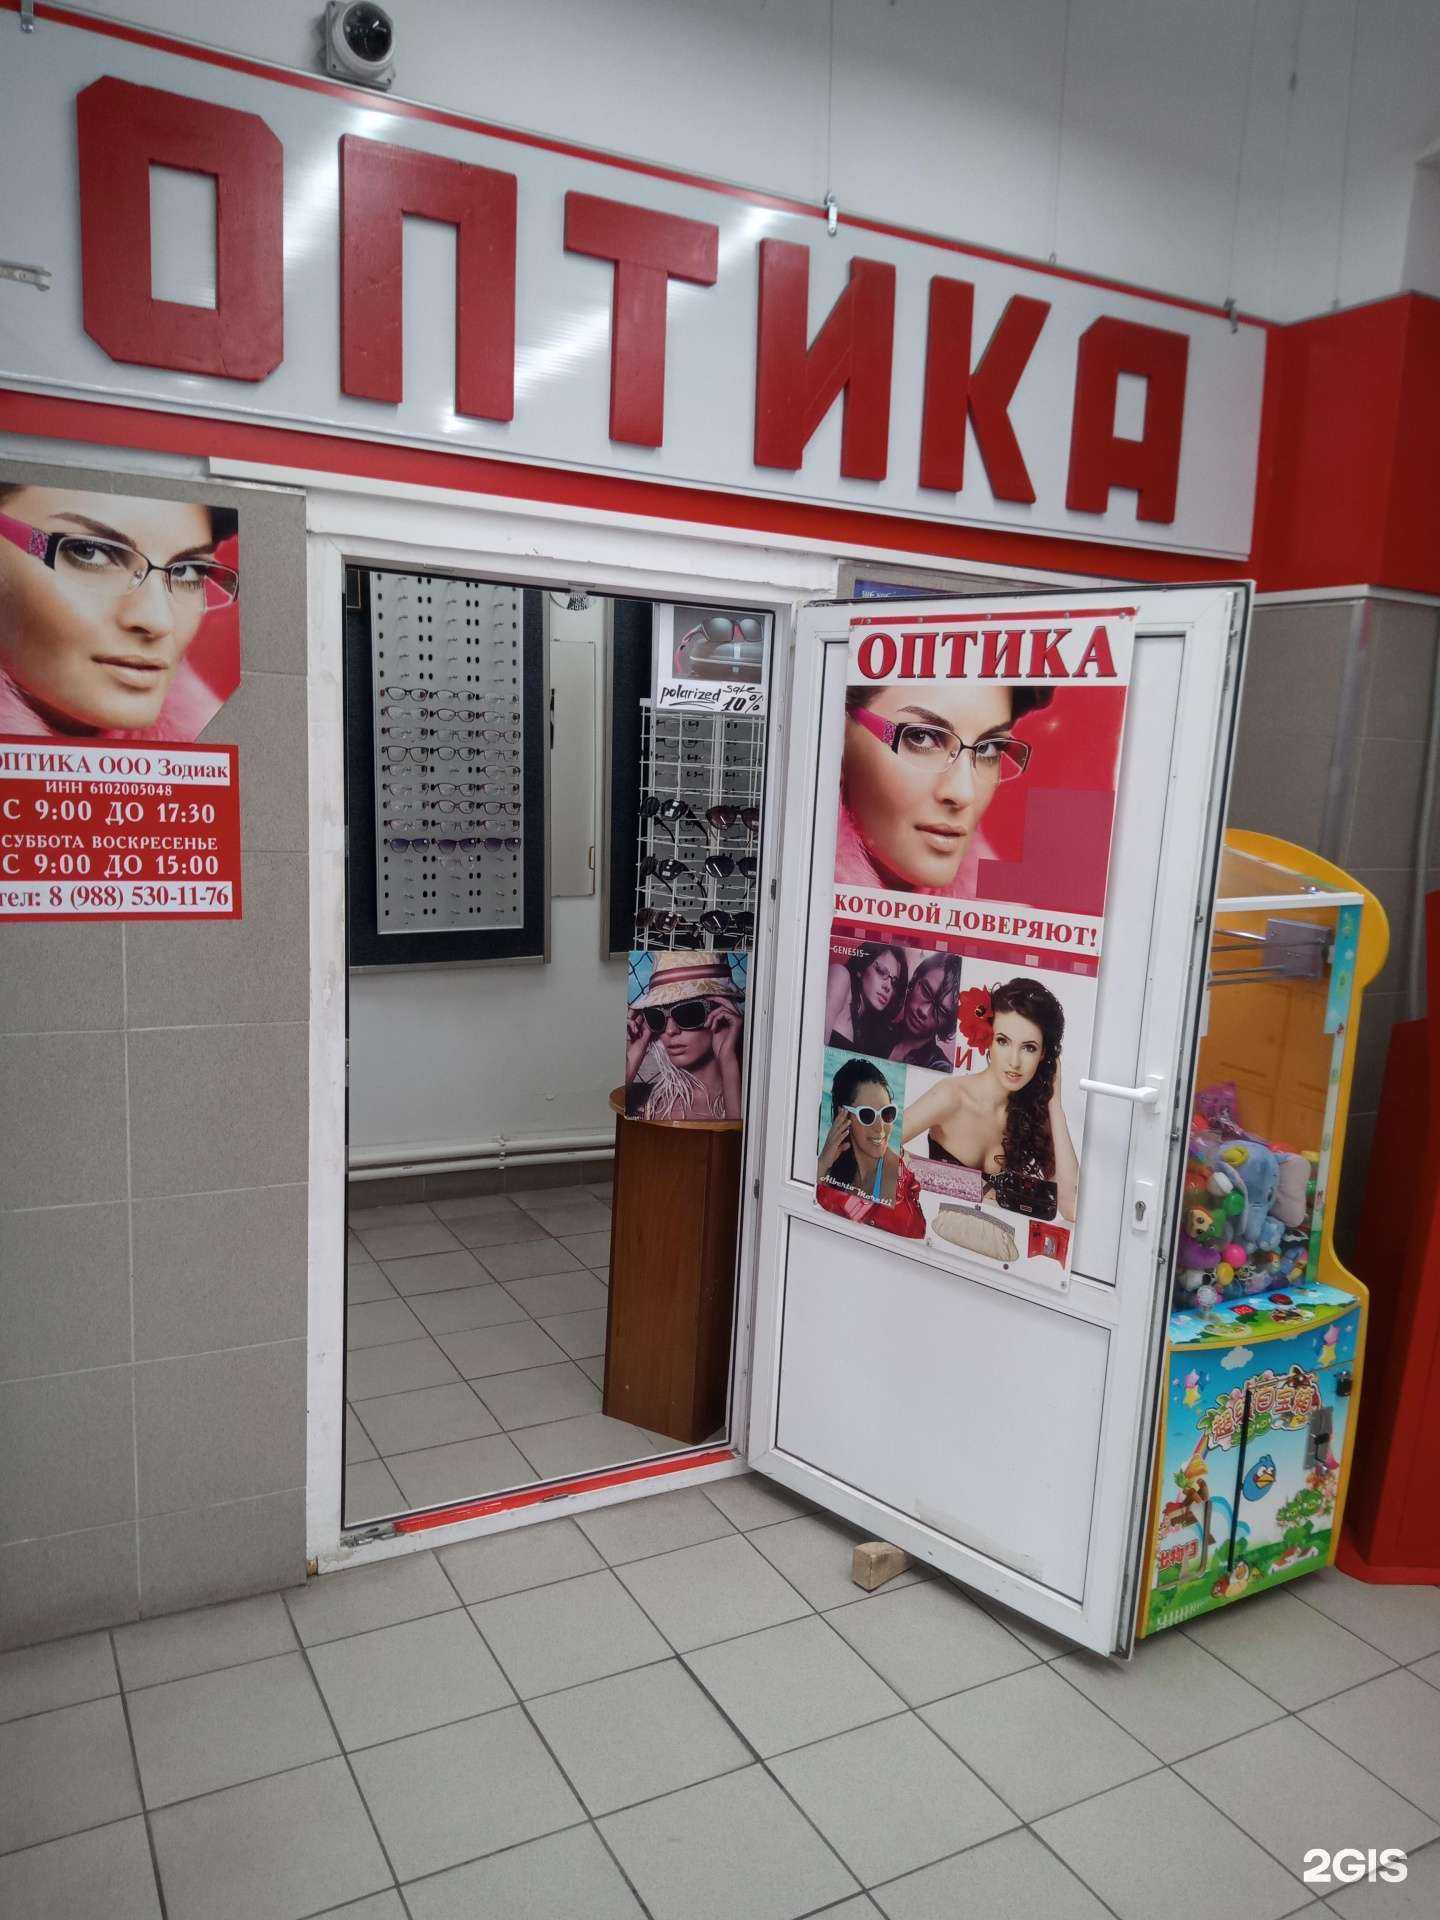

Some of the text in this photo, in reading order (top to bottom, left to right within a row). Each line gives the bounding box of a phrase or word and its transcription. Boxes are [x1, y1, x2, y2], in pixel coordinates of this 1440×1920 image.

[76, 75, 1189, 523] ОПТИКА
[857, 626, 1117, 680] ОПТИКА
[660, 685, 722, 705] polarized
[721, 694, 763, 714] 10%
[0, 751, 228, 780] ПТИКА ООО Зодиак
[46, 781, 173, 796] ИНН 6102005048
[3, 799, 215, 825] С 9:00 ДО 17:30
[1, 835, 218, 850] СУББОТА ВОСКРЕСЕНЬЕ
[2, 854, 219, 878] С 9:00 ДО 15:00
[49, 886, 63, 906] 8
[70, 885, 124, 910] (988)
[131, 885, 229, 906] 530-11-76
[834, 893, 1098, 947] КОТОРОЙ ДОВЕРЯЮТ!
